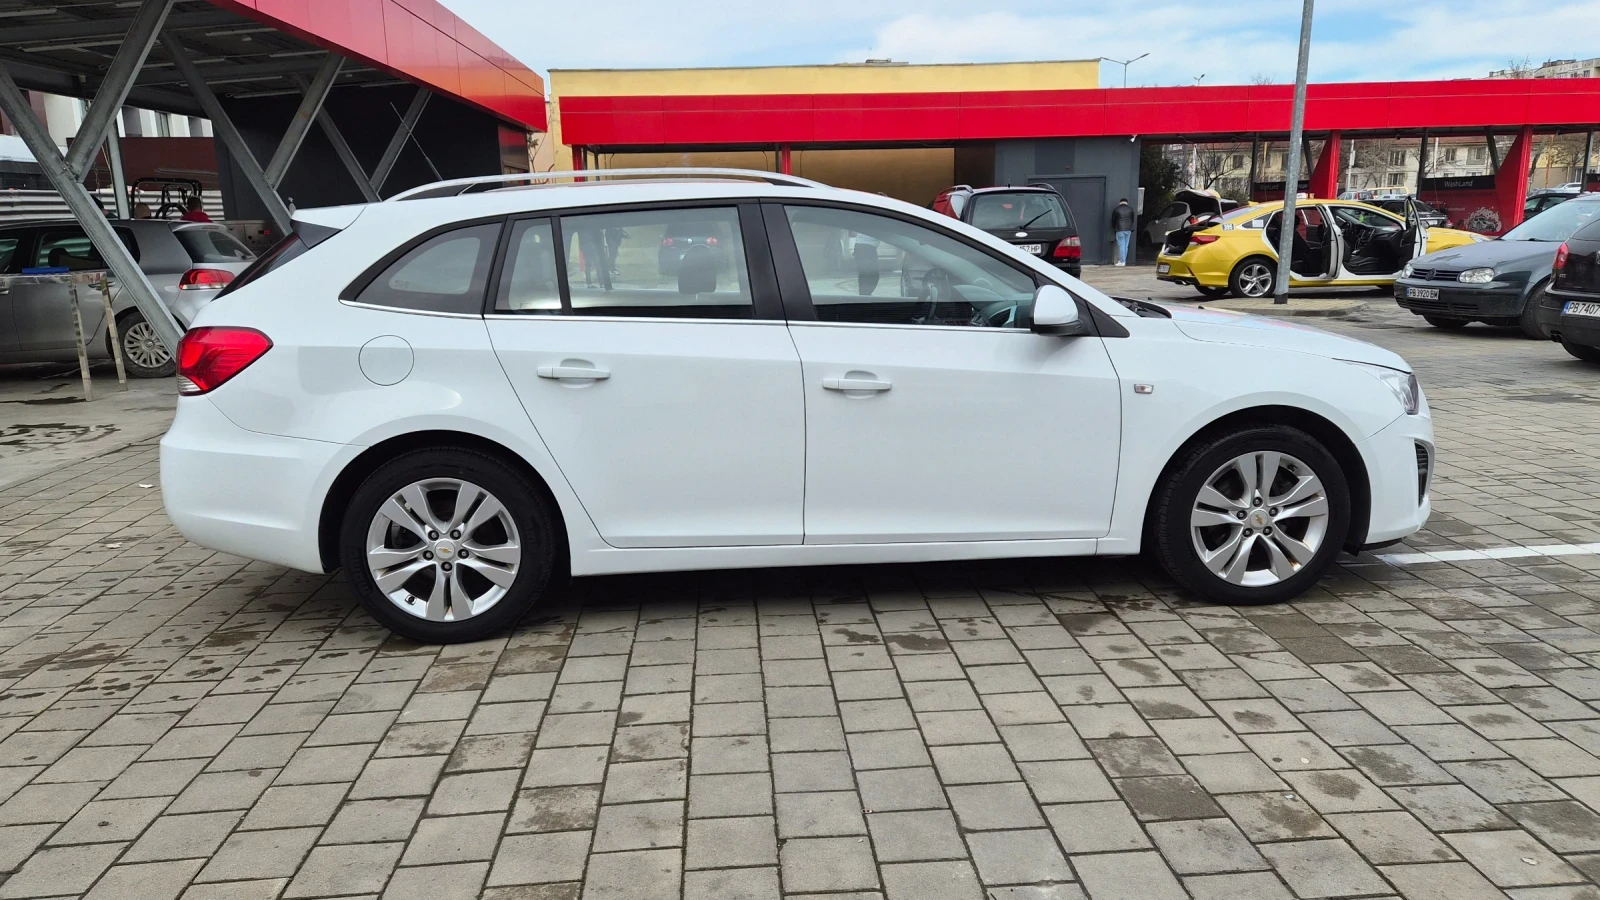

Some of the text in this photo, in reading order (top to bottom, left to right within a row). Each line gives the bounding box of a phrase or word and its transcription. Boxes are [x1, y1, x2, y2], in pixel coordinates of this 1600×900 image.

[1444, 180, 1474, 188] WashLand
[1409, 288, 1416, 297] PB
[1416, 289, 1430, 298] 3920
[1567, 302, 1600, 314] PB 7407
